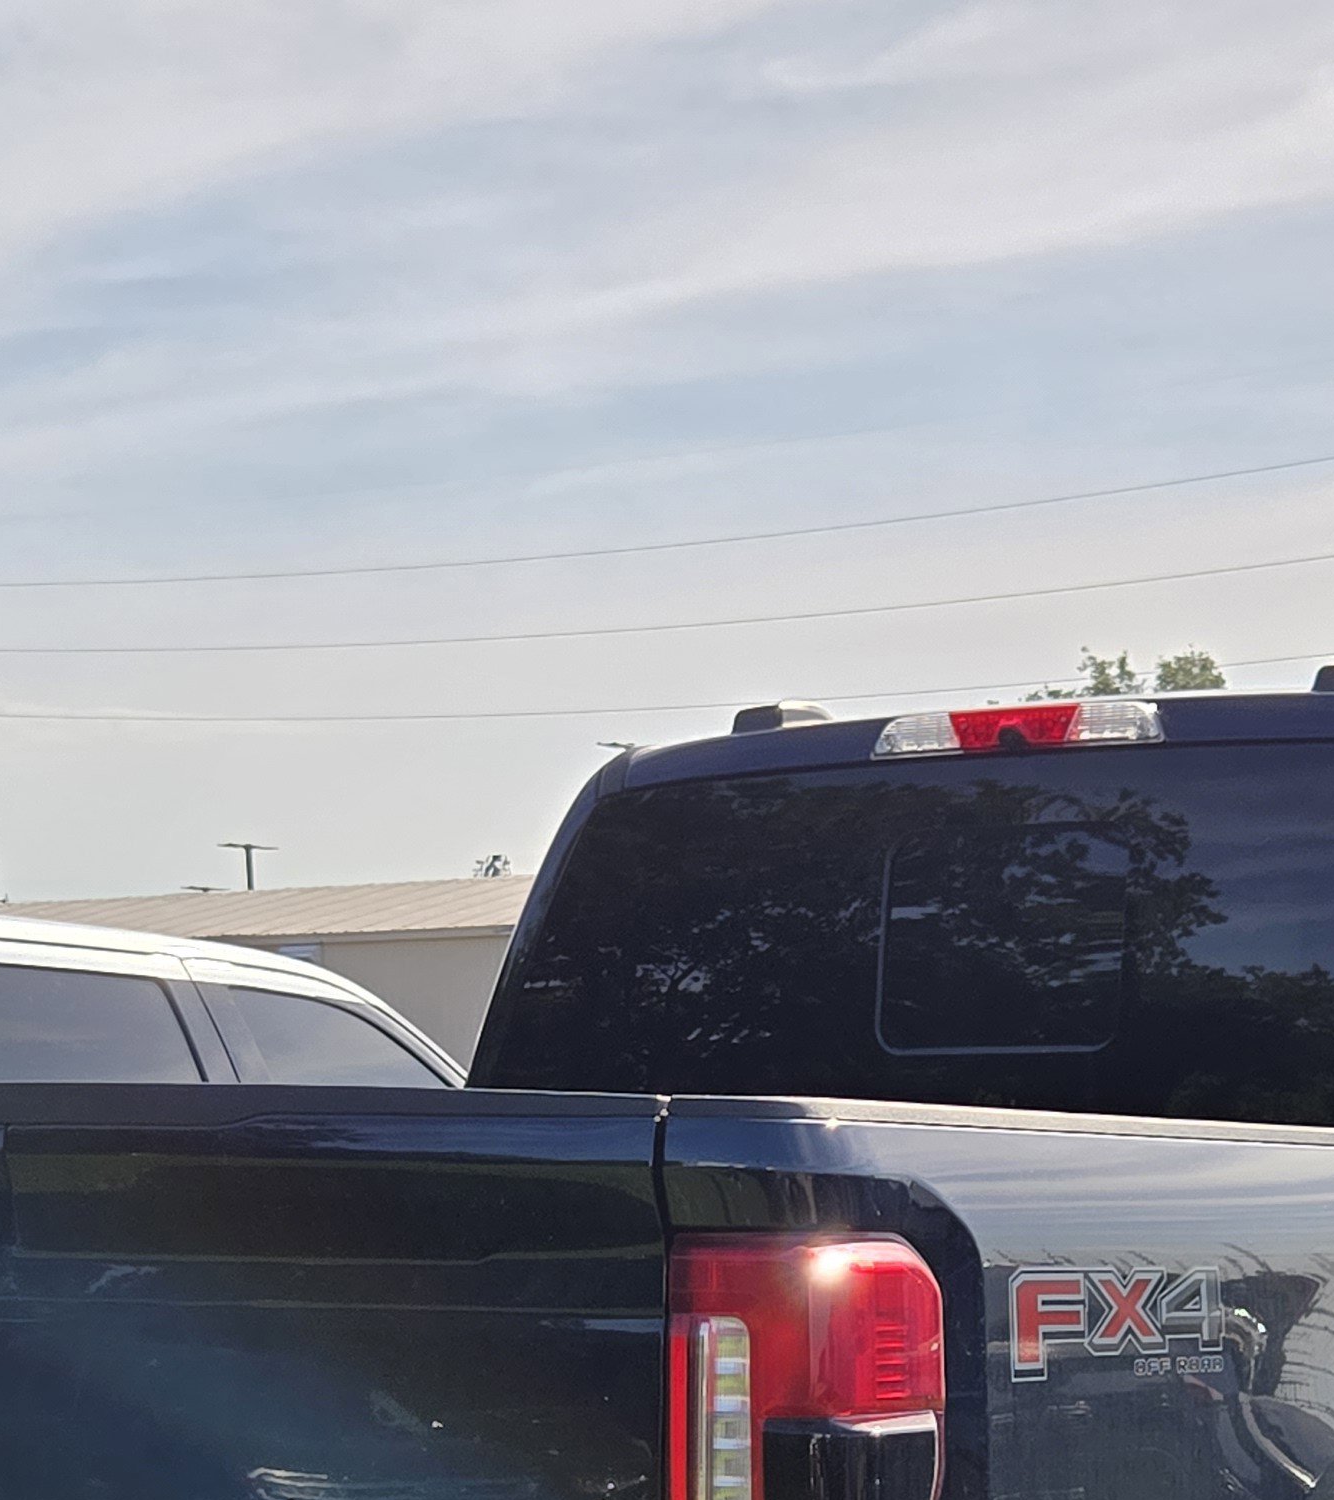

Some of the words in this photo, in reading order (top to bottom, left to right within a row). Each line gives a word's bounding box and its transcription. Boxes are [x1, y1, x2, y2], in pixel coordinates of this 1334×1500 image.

[1009, 1266, 1223, 1383] FX4
[1133, 1358, 1171, 1376] OFF
[1176, 1356, 1224, 1374] ROAD
